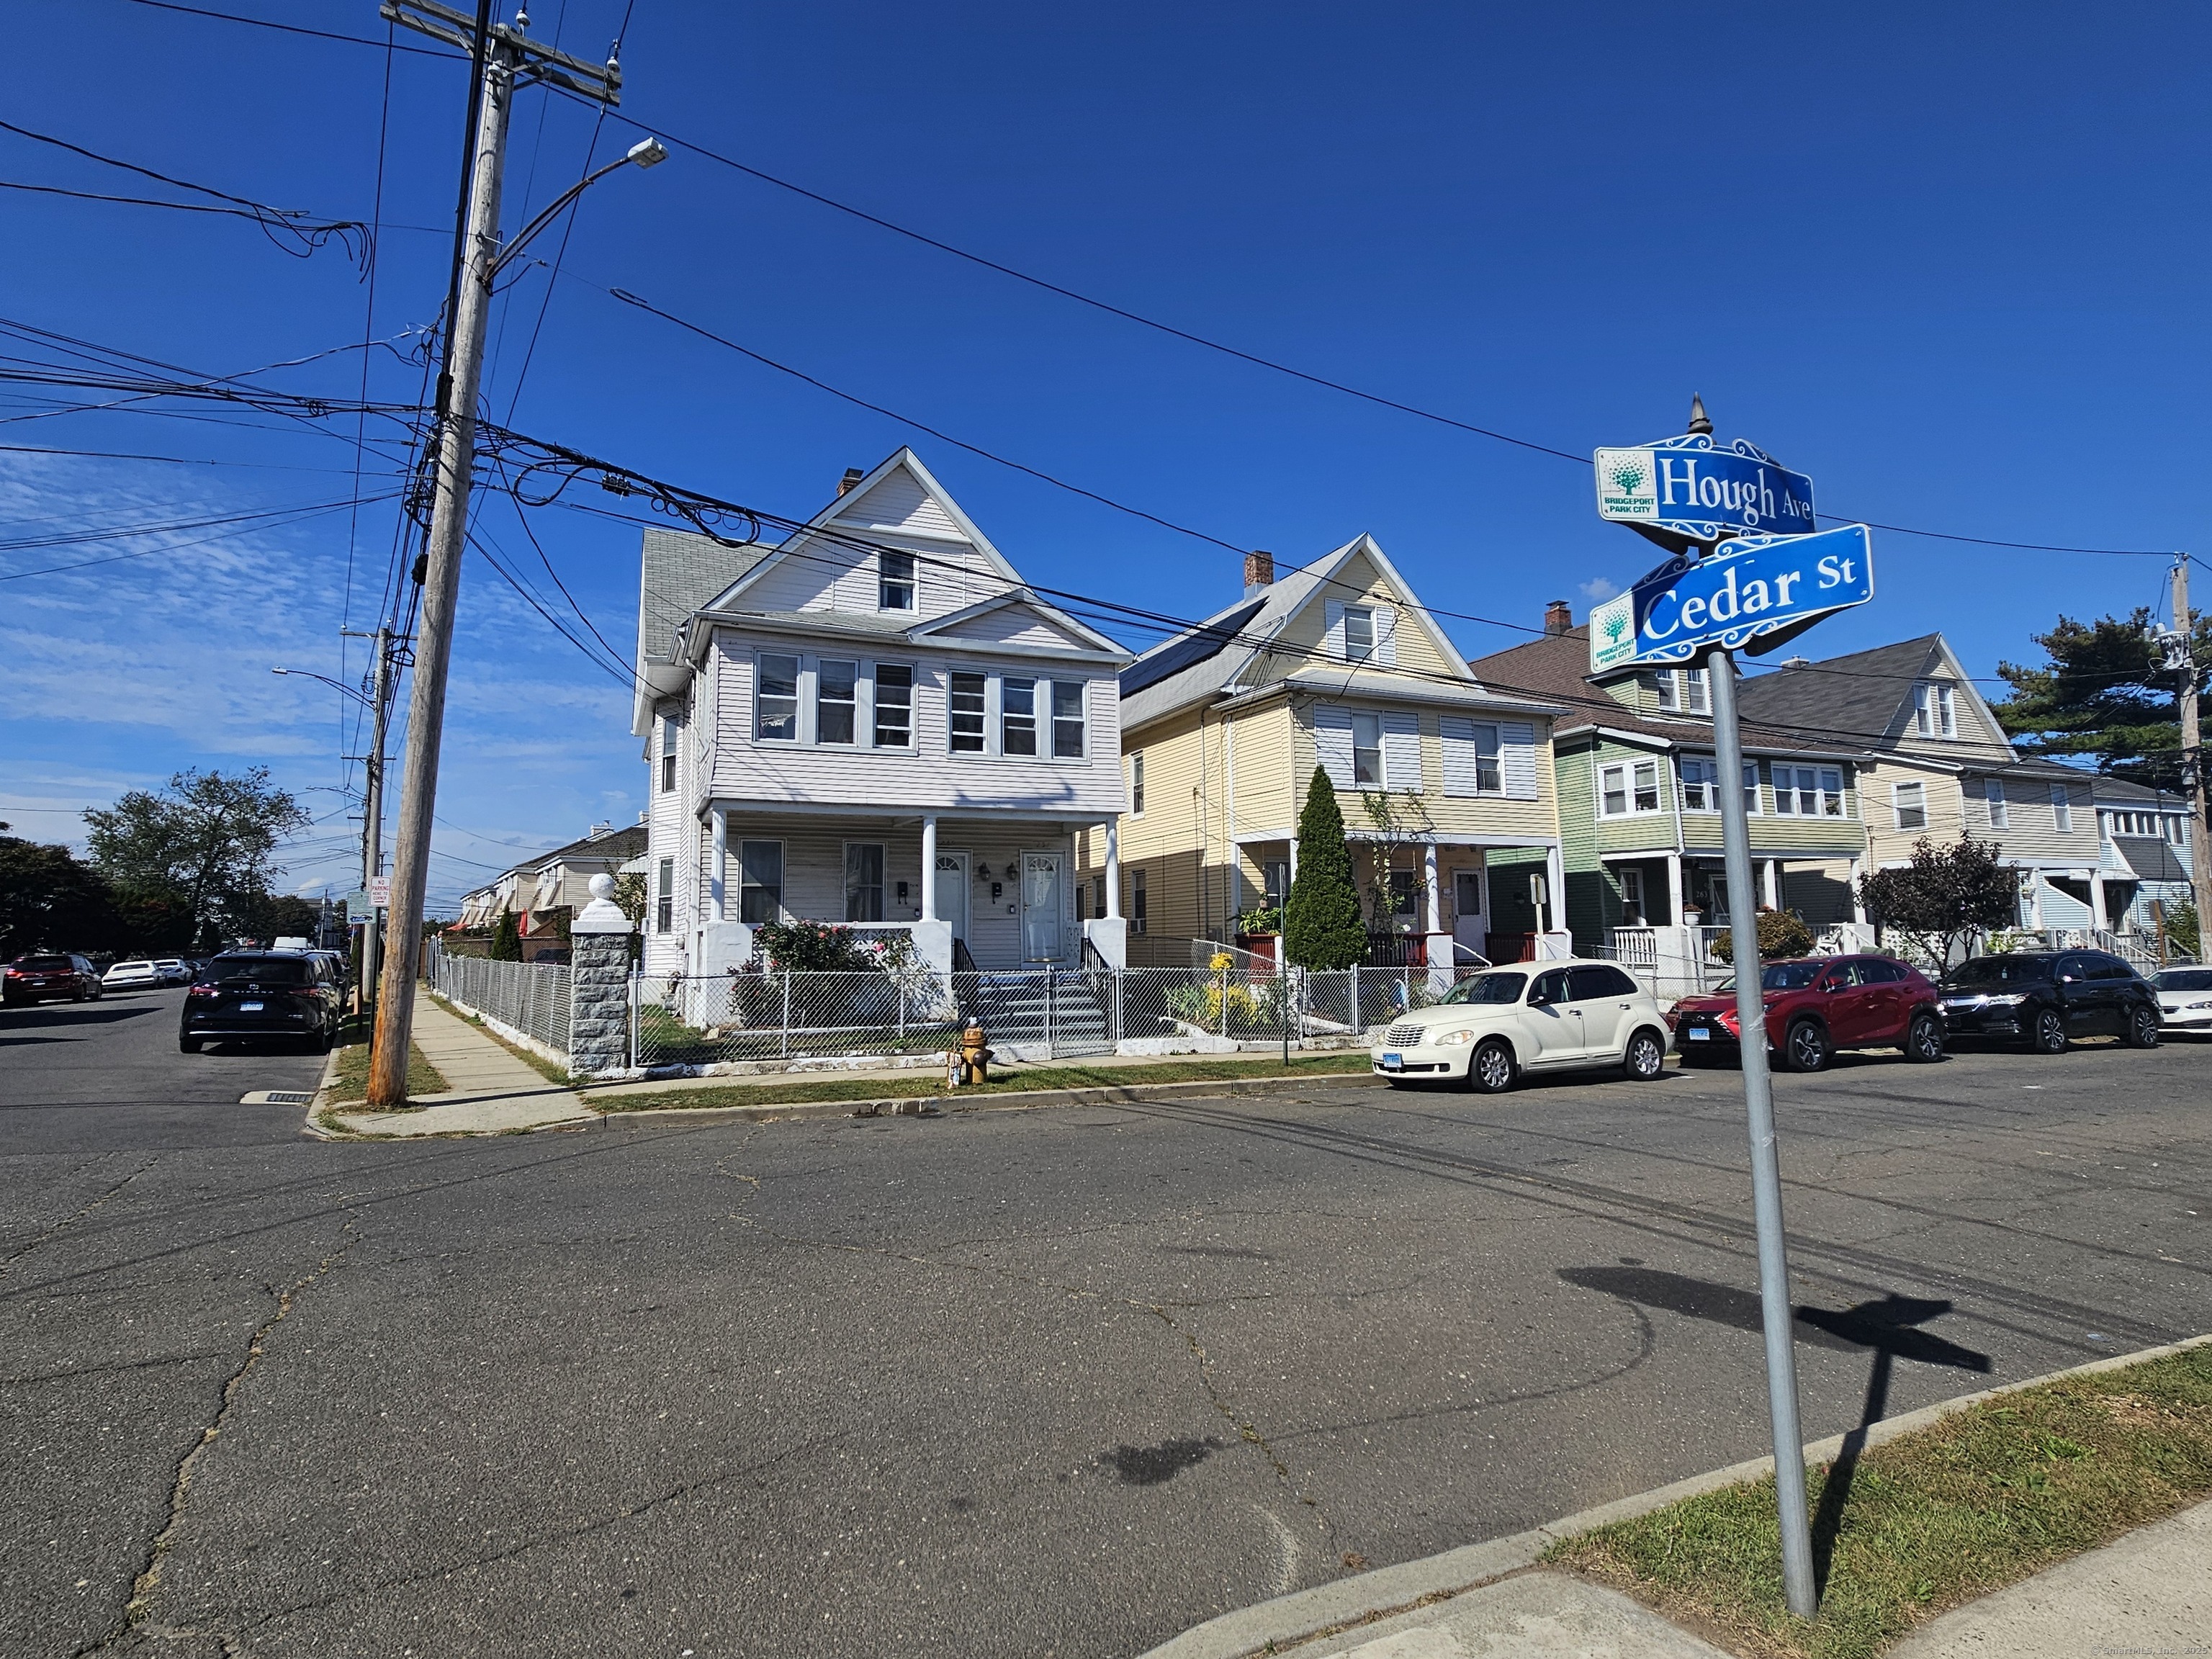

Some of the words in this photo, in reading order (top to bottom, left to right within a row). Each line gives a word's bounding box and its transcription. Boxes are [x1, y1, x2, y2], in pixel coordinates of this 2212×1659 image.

[1604, 497, 1655, 505] BRIDGEPORT
[1659, 458, 1776, 526] Hough
[1782, 495, 1812, 521] Ave
[1643, 566, 1800, 639] Cedar
[1817, 555, 1858, 589] St
[1596, 639, 1634, 659] BRIDGEPORT
[1600, 653, 1617, 665] PARK
[1618, 647, 1632, 658] CITY
